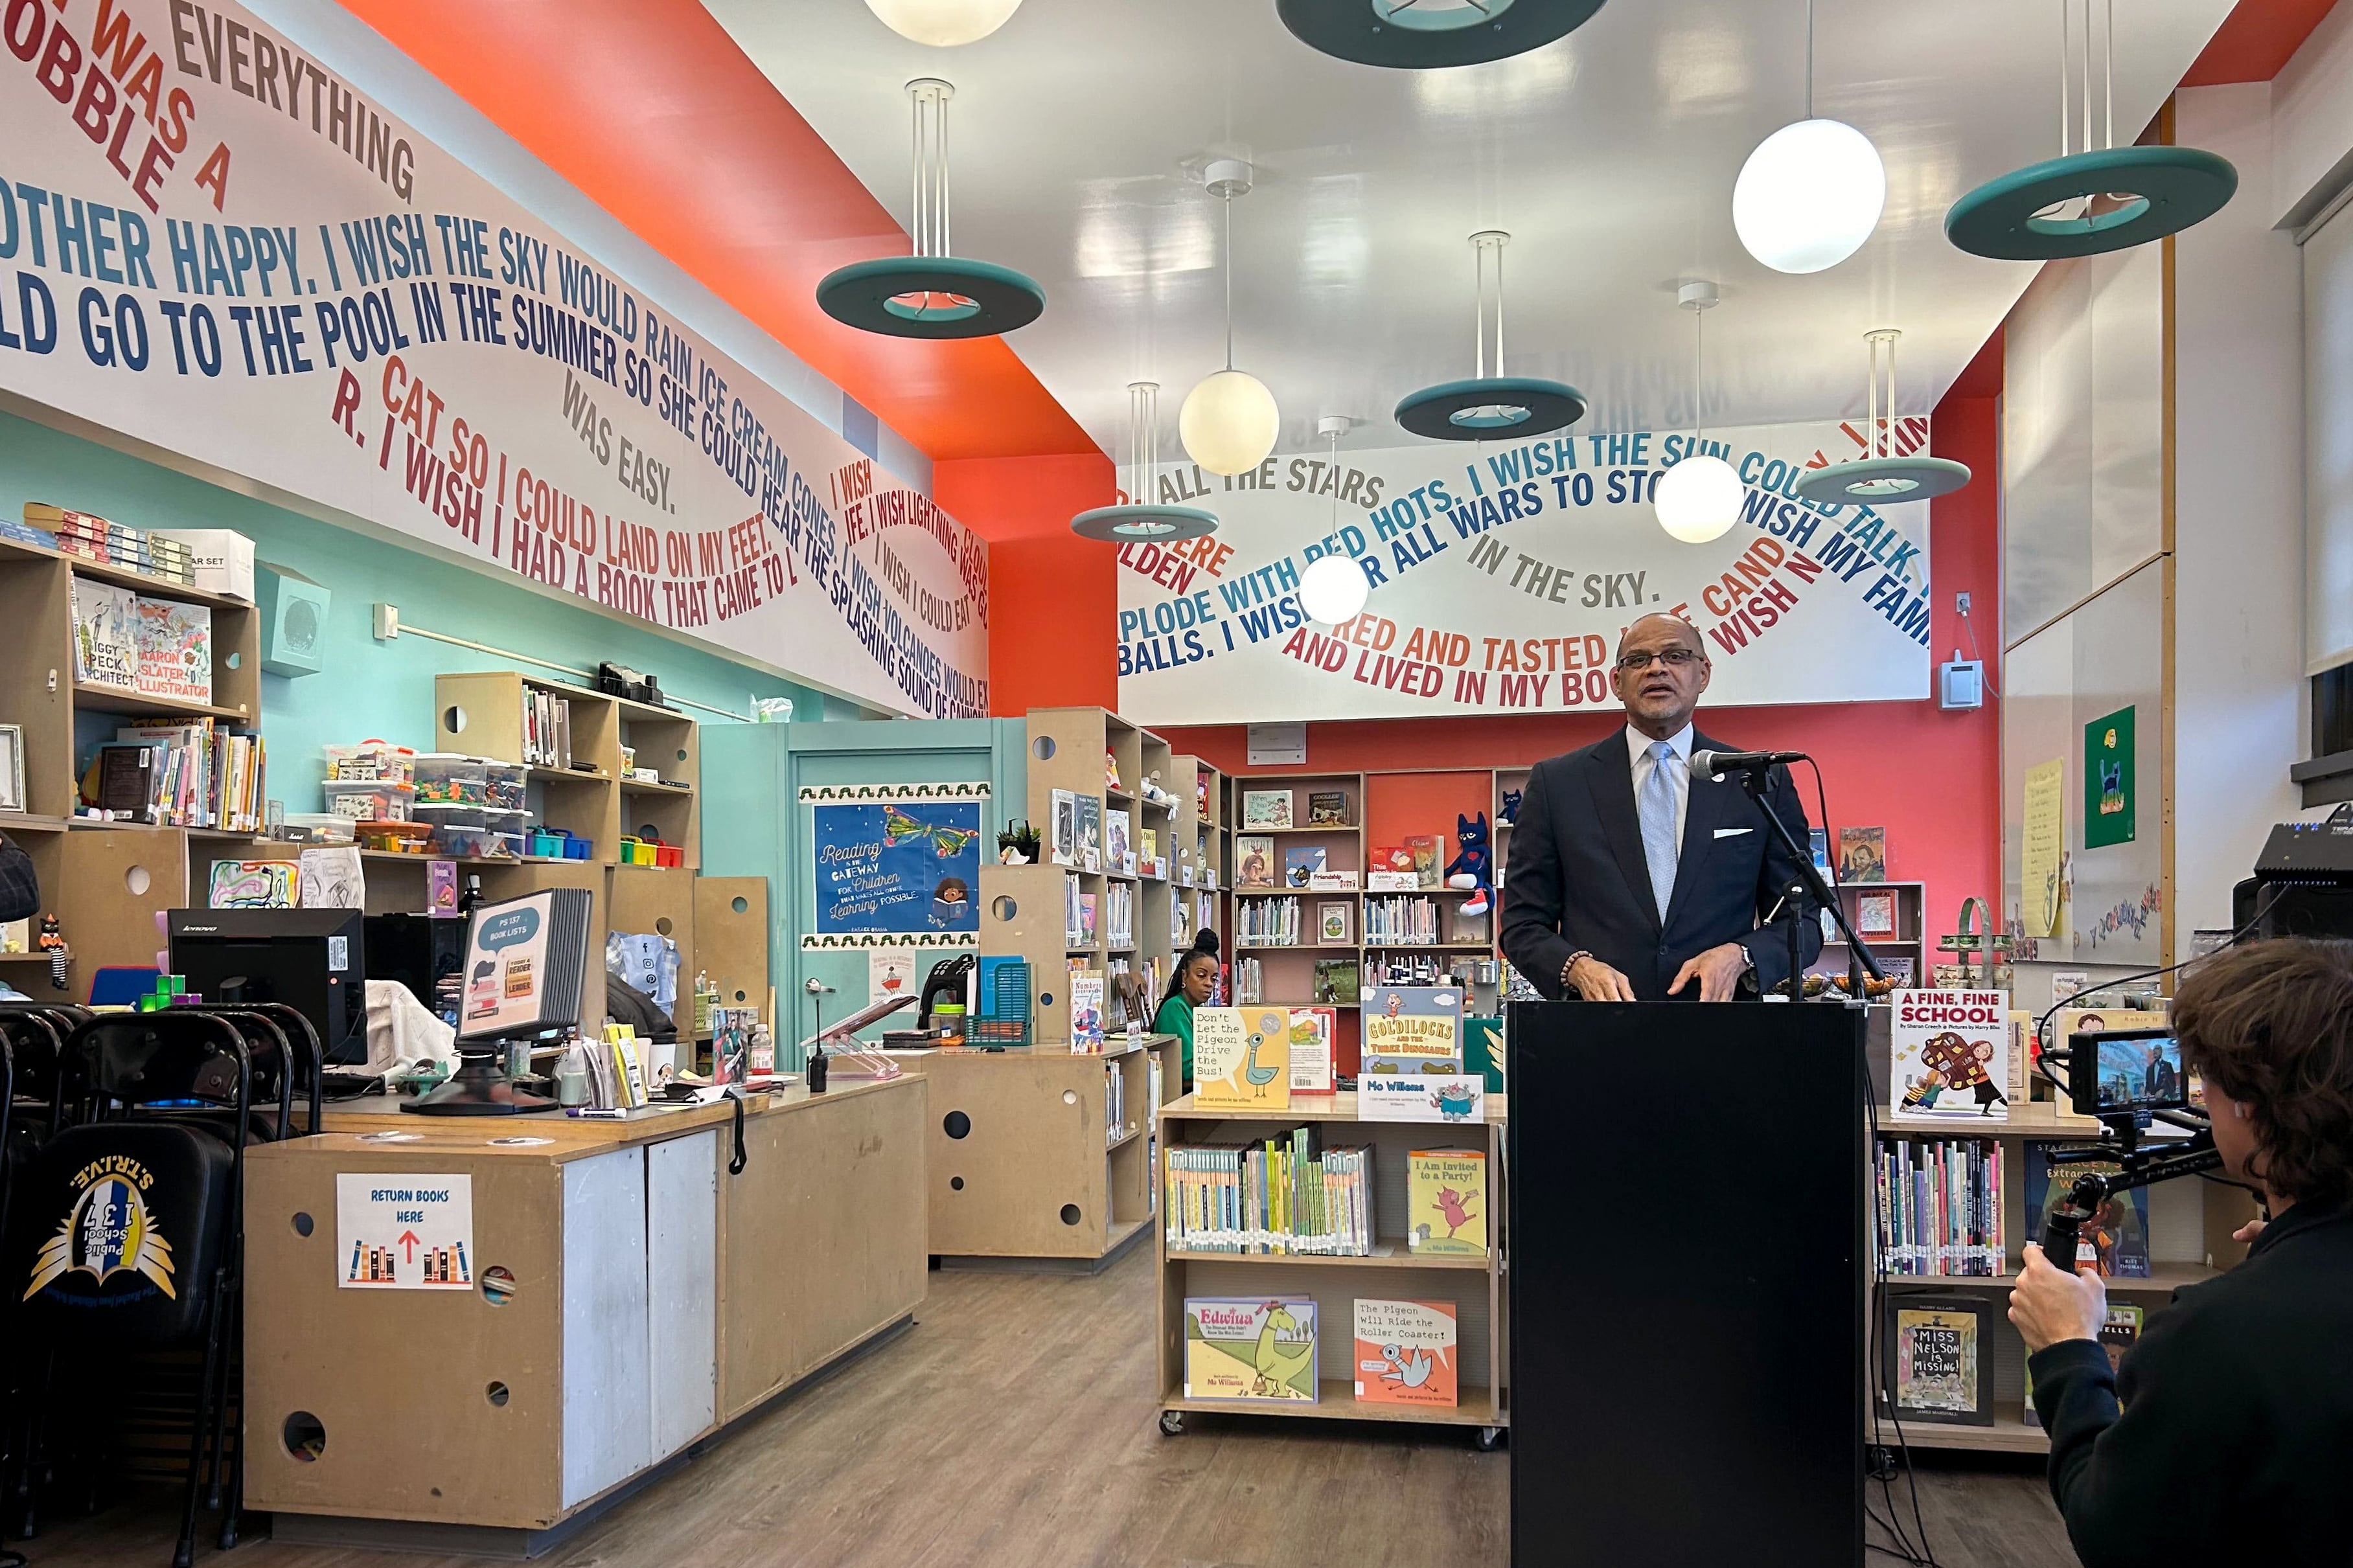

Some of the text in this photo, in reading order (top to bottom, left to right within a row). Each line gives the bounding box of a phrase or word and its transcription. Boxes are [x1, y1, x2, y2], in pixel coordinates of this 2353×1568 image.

[169, 0, 413, 205] EVERYTHING
[194, 141, 231, 213] A
[563, 368, 675, 515] WAS EASY.
[166, 214, 974, 707] HAPPY. I WISH THE SKY WOULD RAIN ICE CREAM CONES. I WISH VOLCANOES WOULD
[383, 356, 772, 577] CAT SO I COULD LAND ON MY FEET.
[1159, 459, 1384, 508] ALL STARS
[78, 282, 932, 713] GO TO THE POOL IN THE SUMMER SO SHE COULD HEAR THE SPLASHING SOUND
[379, 413, 783, 627] I WISH I HAD A BOOK THAT CAME TO
[869, 490, 958, 565] I WISH LIGHTNING
[1218, 433, 1921, 613] WITH HOTS. I WISH THE TALK.
[1118, 473, 1876, 677] BALLS. I ALL WARS TO MY
[1467, 534, 1660, 608] IN THE SKY.
[875, 532, 970, 632] I WISH I COULD EAT
[94, 642, 119, 655] IGGY
[1282, 578, 1799, 706] AND LIVED IN MY WISH
[1403, 627, 1606, 672] AND TASTED
[140, 650, 179, 665] AARON
[86, 668, 134, 687] RCHITECT
[820, 842, 882, 866] Reading
[832, 863, 878, 881] GATEWAY
[852, 873, 900, 892] Children
[829, 900, 878, 920] Learning
[499, 915, 521, 927] PS 137
[490, 926, 527, 941] BOOK LISTS
[1902, 993, 1999, 1005] A FINE, FINE
[1197, 1014, 1229, 1022] Don't
[1901, 1007, 1999, 1023] SCHOOL
[1197, 1025, 1239, 1033] Let the
[1369, 1019, 1452, 1039] GOLDILOCKS
[1197, 1034, 1237, 1045] Pigeon
[1197, 1045, 1230, 1054] Drive
[1198, 1056, 1217, 1064] the
[1368, 1081, 1425, 1092] Mo Willems
[1443, 1162, 1477, 1171] Invited
[1421, 1171, 1430, 1179] to
[1442, 1172, 1473, 1182] Party!
[371, 1189, 449, 1202] RETURN BOOKS
[396, 1210, 424, 1223] HERE
[84, 1227, 129, 1242] School
[85, 1244, 125, 1257] Public
[1200, 1308, 1253, 1325] Edwina
[1384, 1306, 1418, 1315] Pigeon
[1361, 1315, 1382, 1324] Will
[1388, 1317, 1412, 1326] Ride
[1399, 1330, 1444, 1339] Coaster!
[1914, 1343, 1960, 1355] NELSON
